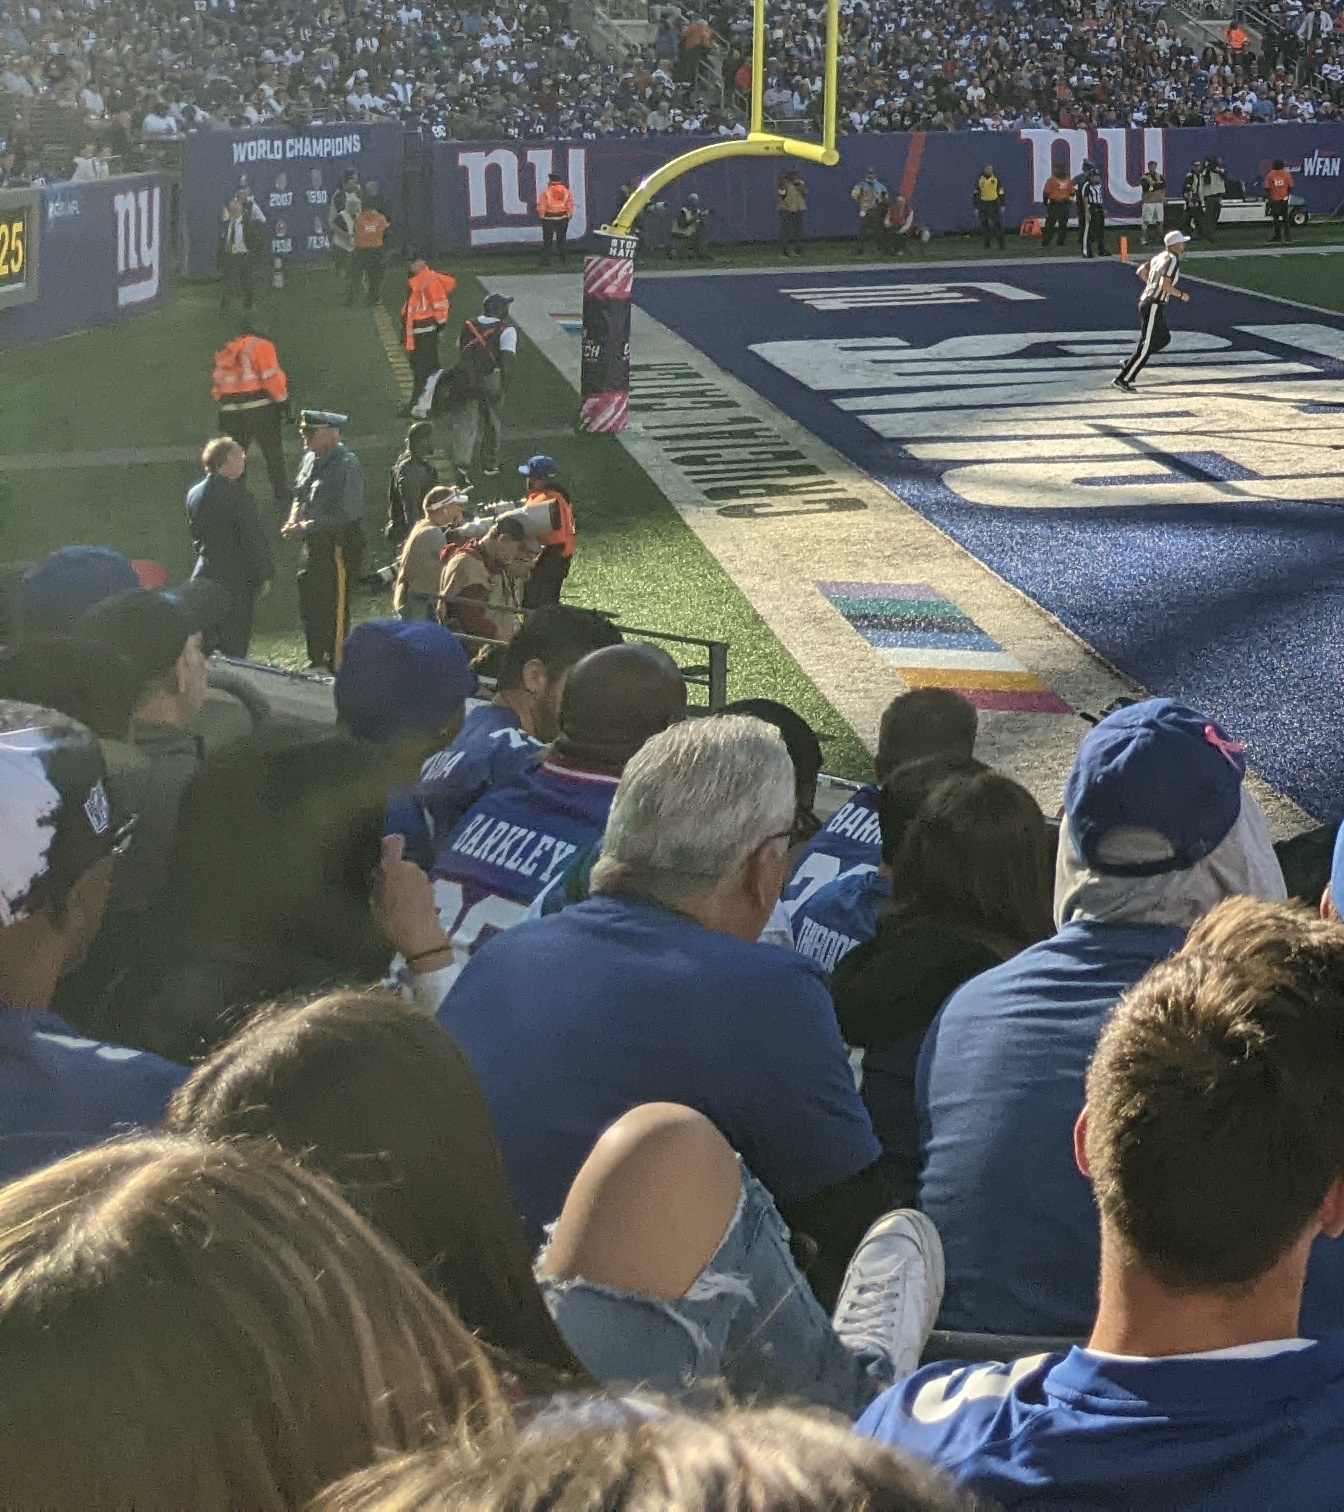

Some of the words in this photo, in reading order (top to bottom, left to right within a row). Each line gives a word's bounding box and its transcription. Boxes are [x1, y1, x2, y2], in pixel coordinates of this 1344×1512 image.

[233, 139, 282, 165] WORLD
[285, 133, 362, 159] CHAMPIONS
[1303, 149, 1341, 178] WFAN
[458, 147, 586, 248] ny
[114, 186, 160, 308] ny
[452, 813, 577, 883] BARKLEY
